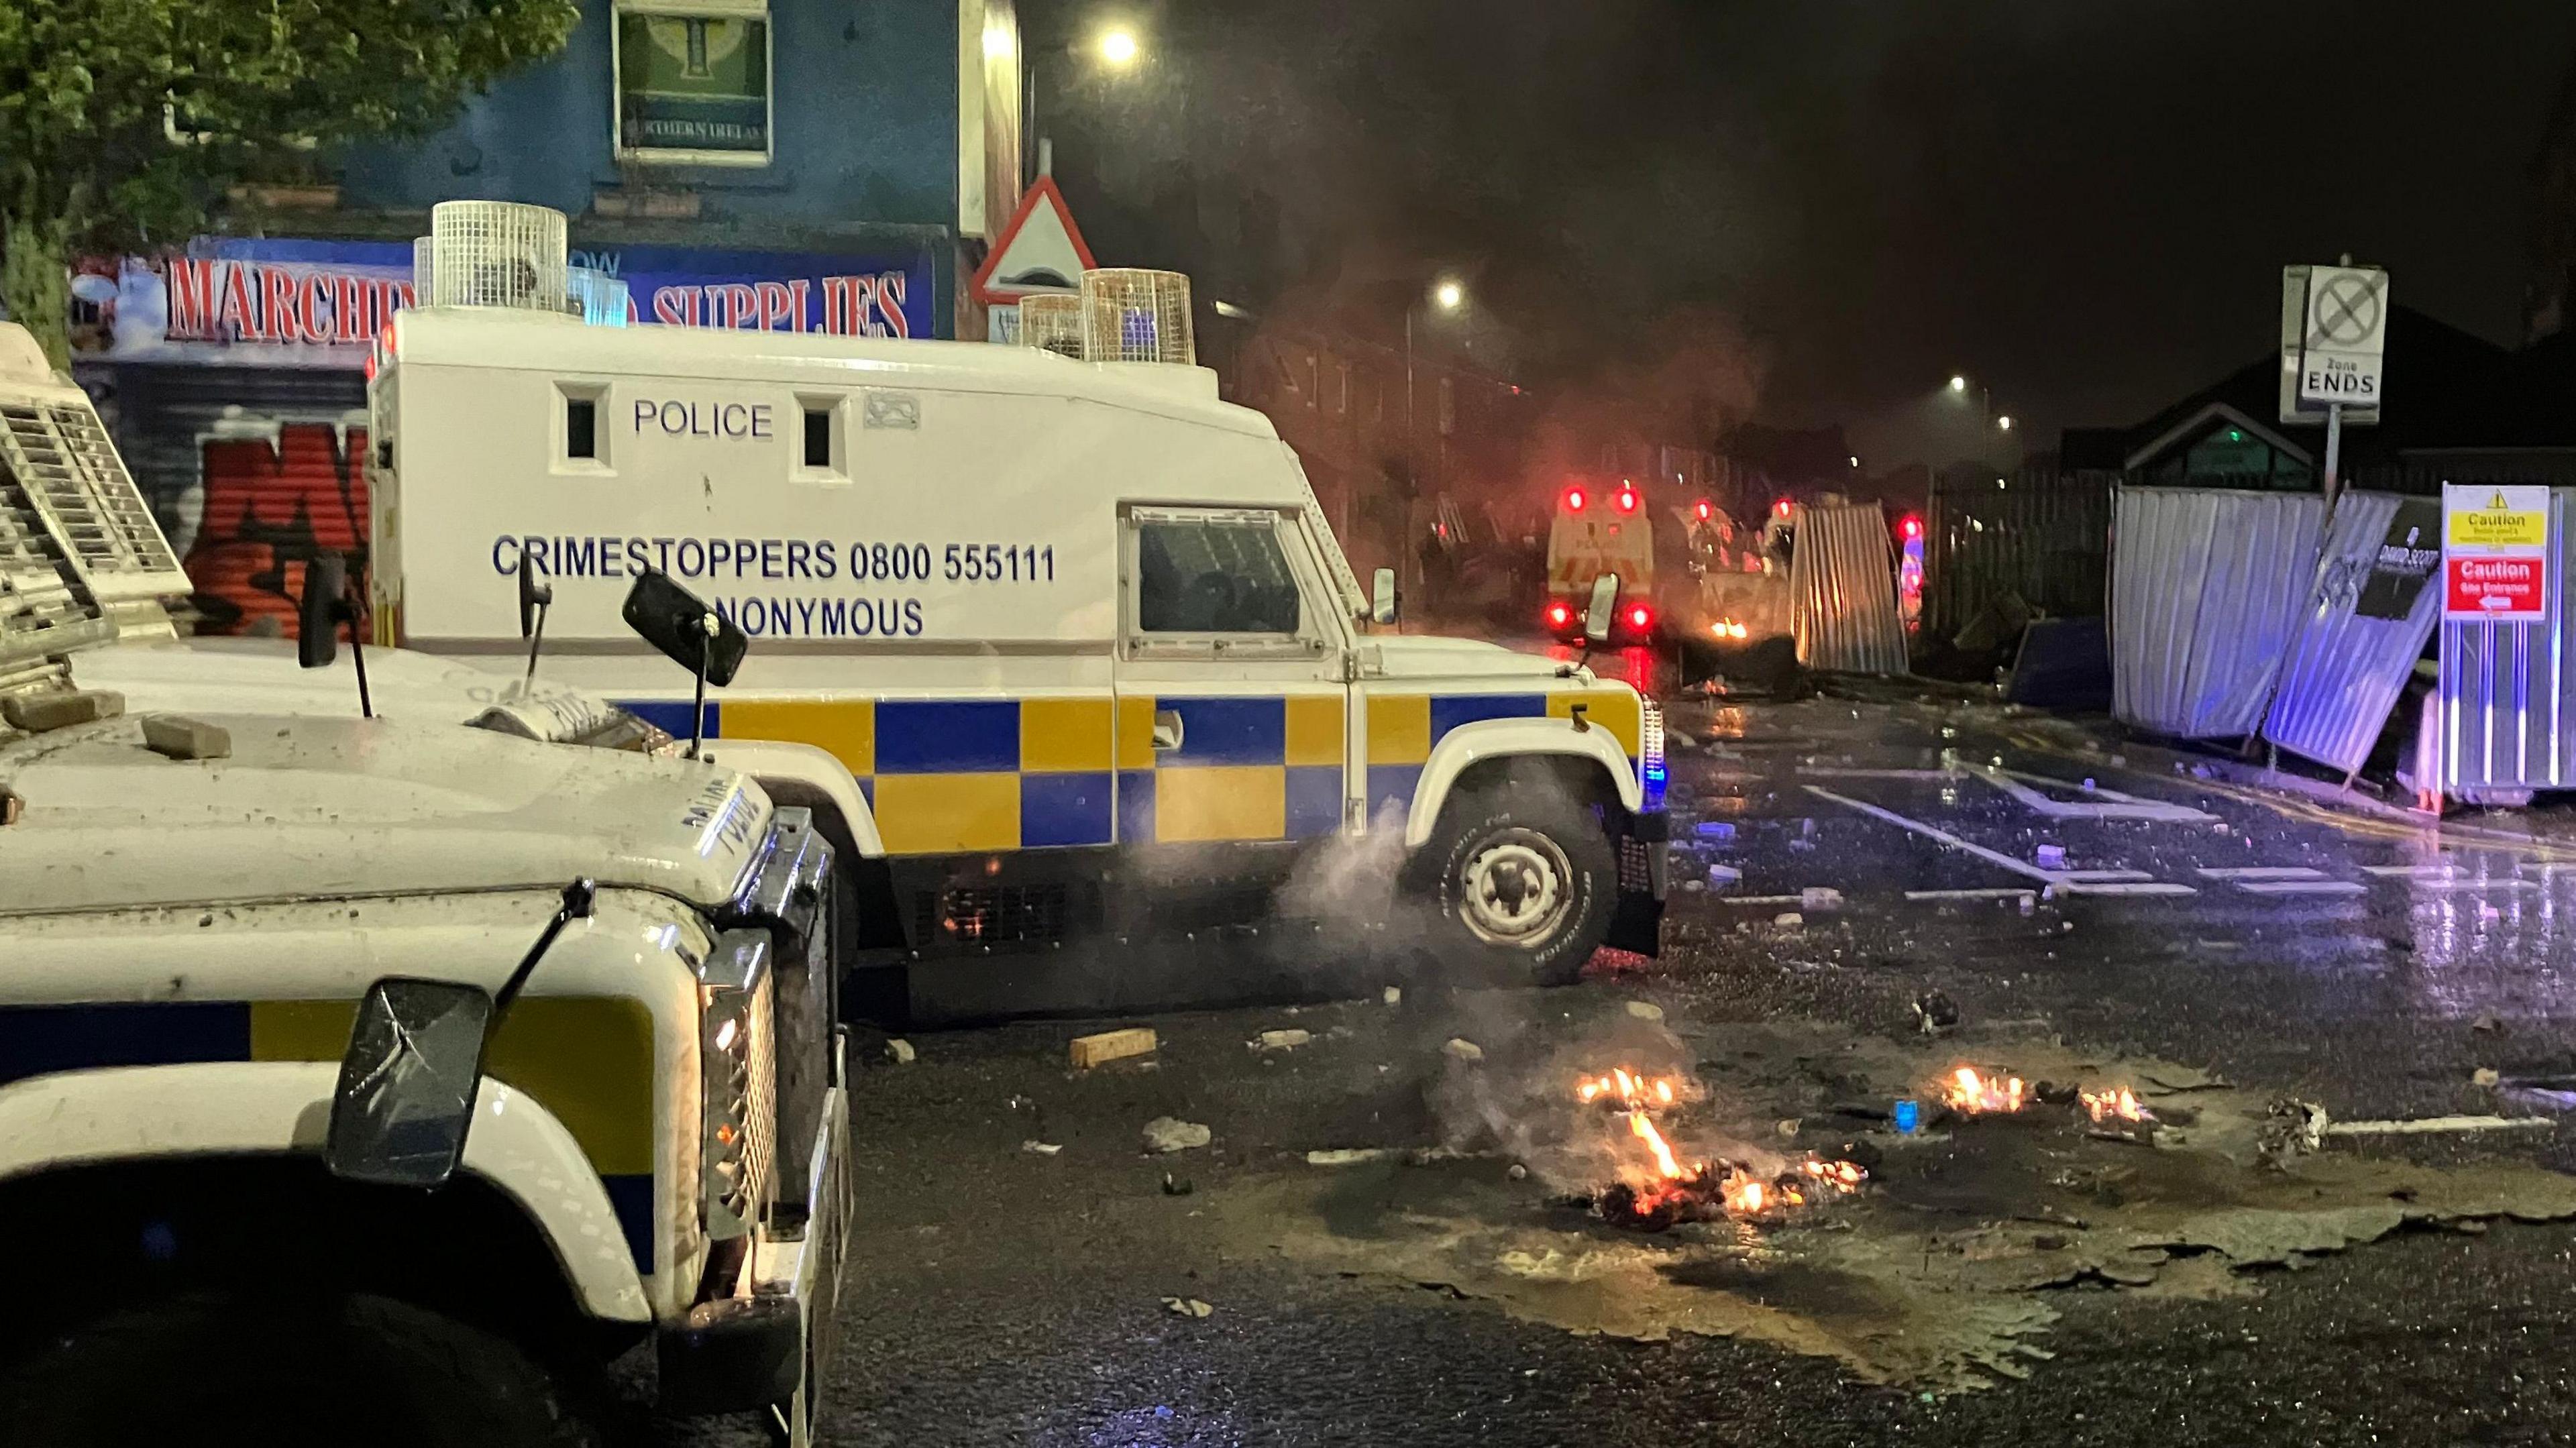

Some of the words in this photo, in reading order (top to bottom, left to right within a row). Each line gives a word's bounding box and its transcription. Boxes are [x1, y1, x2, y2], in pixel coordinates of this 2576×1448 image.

[653, 270, 910, 339] SUPPLIES
[2309, 371, 2373, 393] ENDS
[635, 400, 773, 439] POLICE
[2468, 512, 2526, 526] Caution
[492, 535, 837, 579] CRIMESTOPPERS
[849, 542, 931, 580] 0800
[944, 544, 1054, 581] 555111
[2461, 561, 2530, 580] Caution
[714, 596, 923, 636] NONYMOUS
